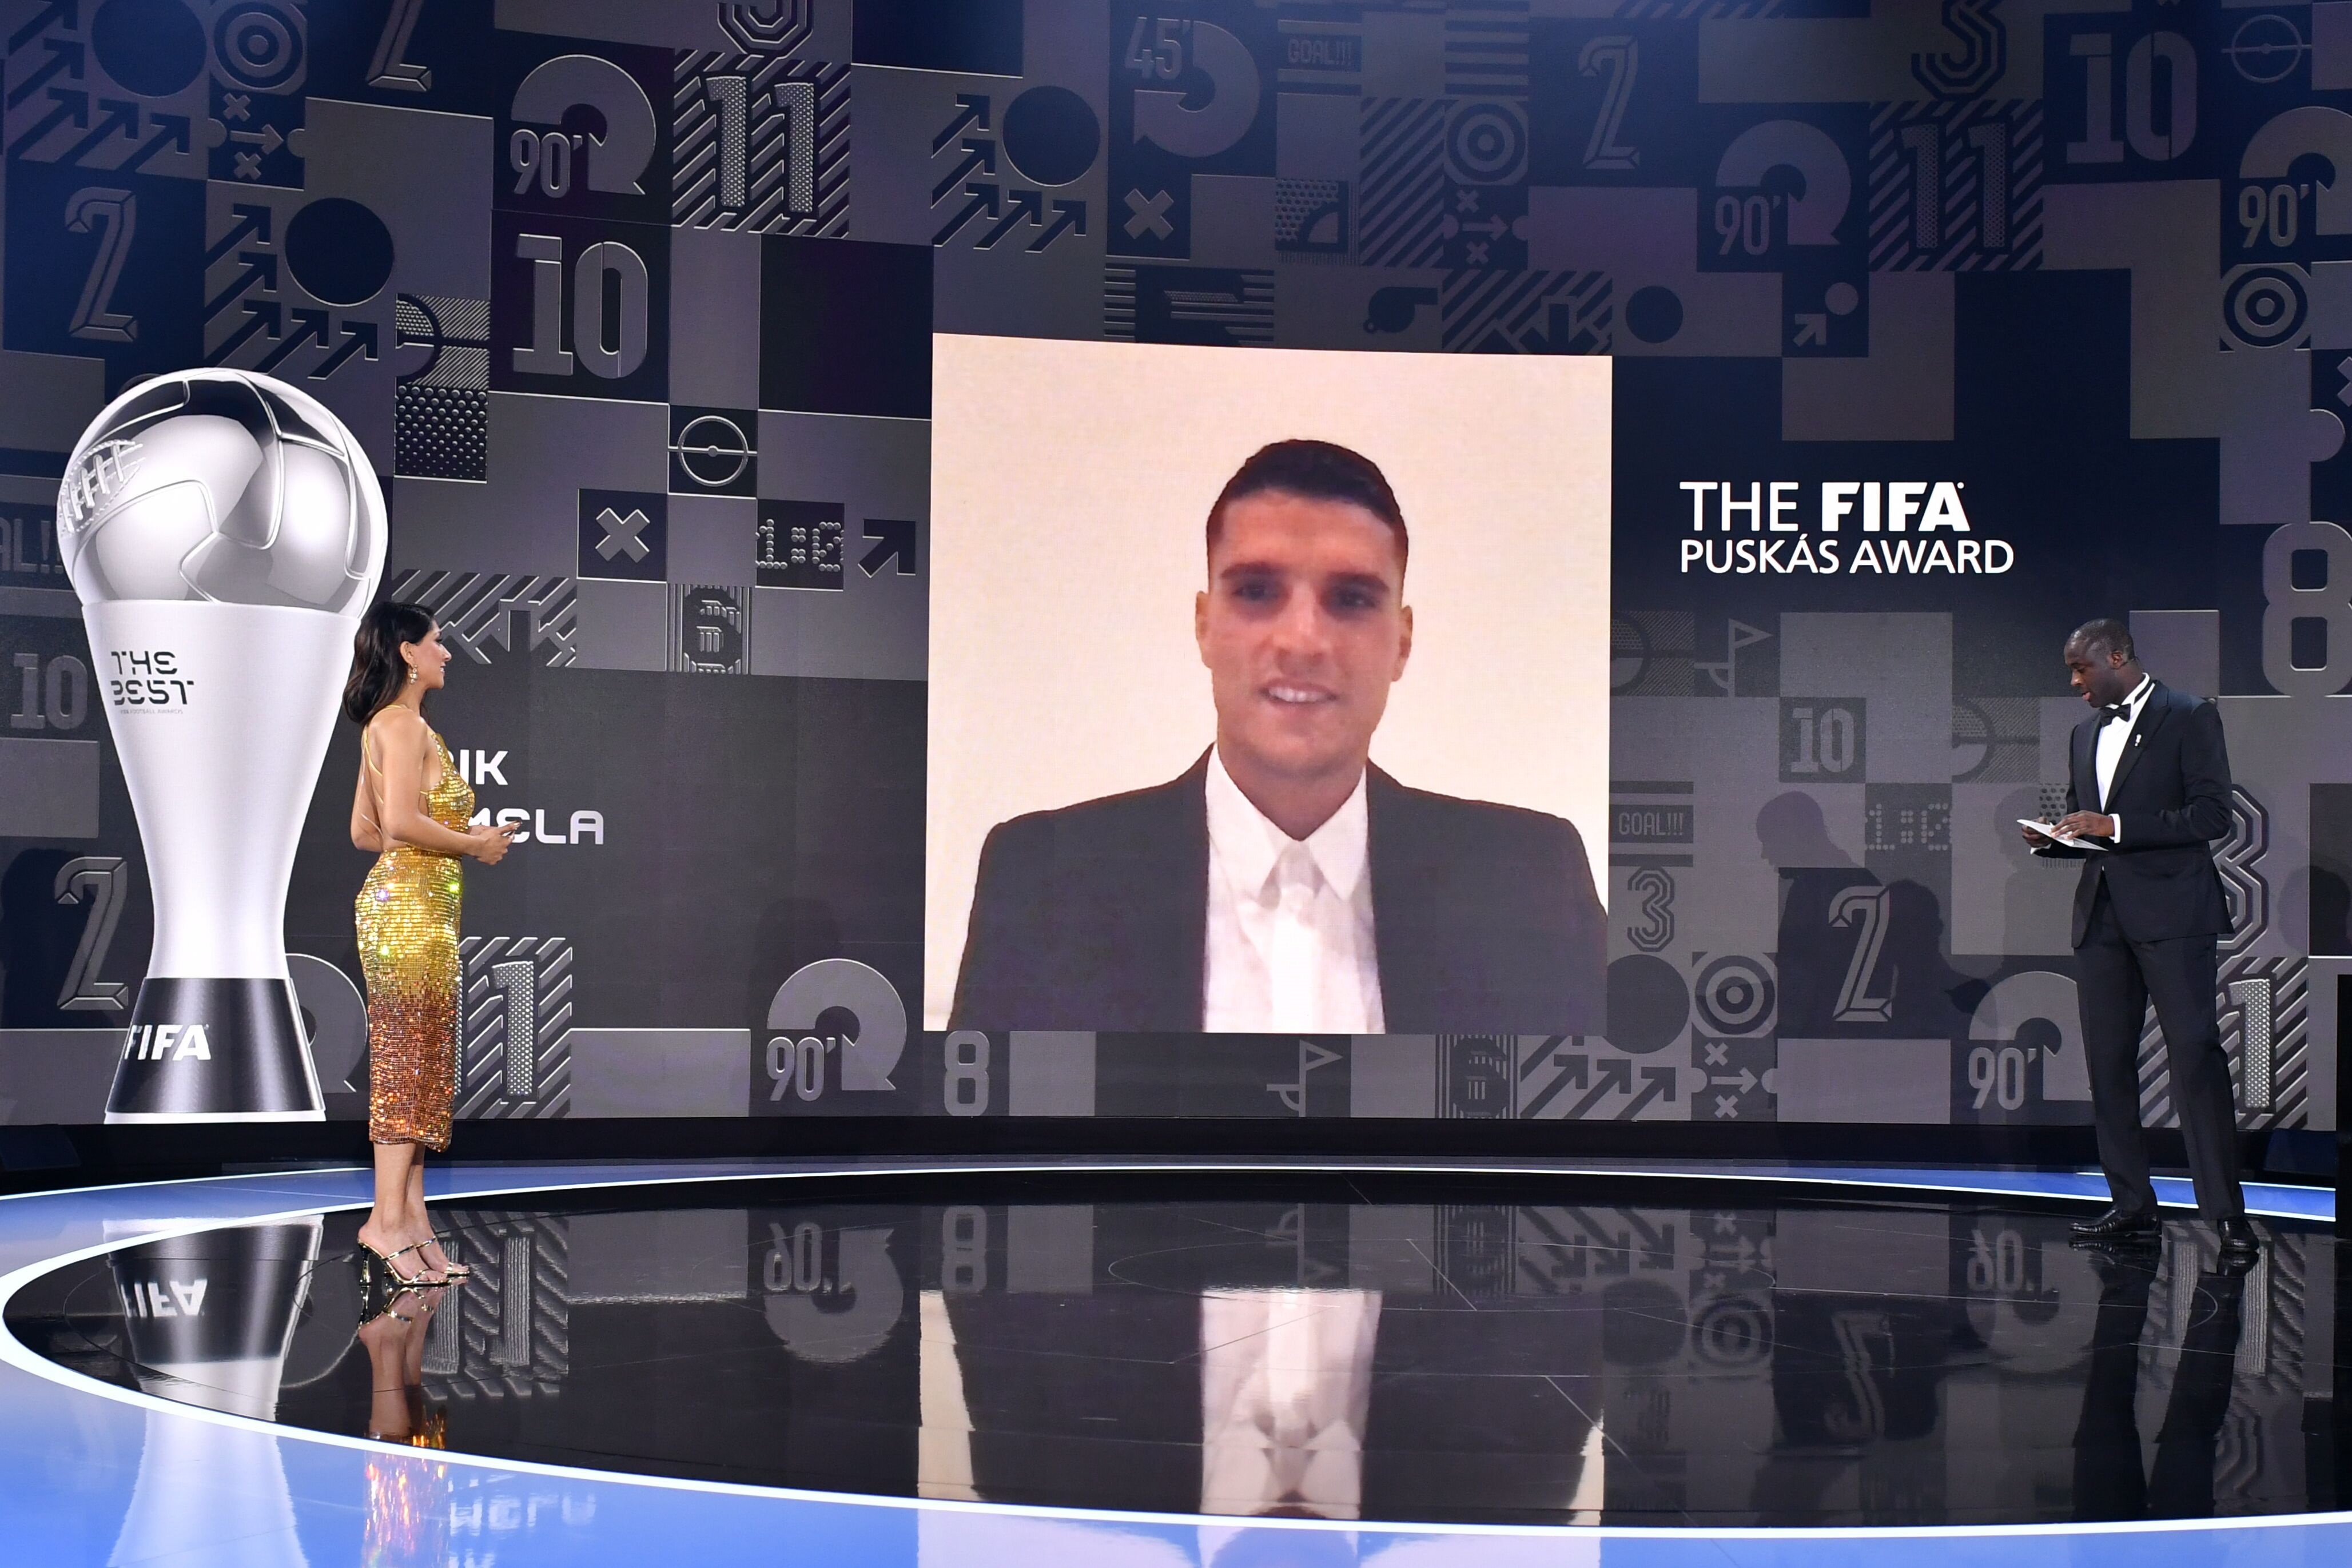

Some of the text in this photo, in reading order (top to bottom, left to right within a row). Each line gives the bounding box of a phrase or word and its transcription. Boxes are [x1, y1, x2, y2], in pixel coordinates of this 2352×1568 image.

[1288, 38, 1352, 65] GOAL!!!
[1578, 35, 1639, 169] 2
[2066, 30, 2197, 164] 10
[510, 129, 582, 198] 90'
[706, 76, 814, 213] 11
[1901, 122, 2007, 249] 11
[2238, 184, 2310, 248] 90'
[1716, 195, 1781, 255] 90'
[65, 186, 137, 342] 2
[514, 233, 648, 379] 10
[1680, 481, 1971, 532] THE FIFA
[1681, 533, 2014, 574] PUSKÁS AWARD
[2262, 521, 2352, 696] 8
[10, 652, 87, 729] 10
[110, 680, 194, 706] BEST
[111, 651, 177, 675] THE
[449, 749, 508, 785] IK
[1791, 707, 1854, 773] 10
[1618, 811, 1684, 836] GOAL!!!
[54, 856, 128, 1010] 2
[1627, 867, 1674, 952] 3
[1829, 886, 1892, 1022] 2
[124, 1024, 211, 1061] FIFA
[766, 1036, 835, 1101] 90'
[944, 1030, 990, 1116] 8
[1968, 1047, 2036, 1110] 90'
